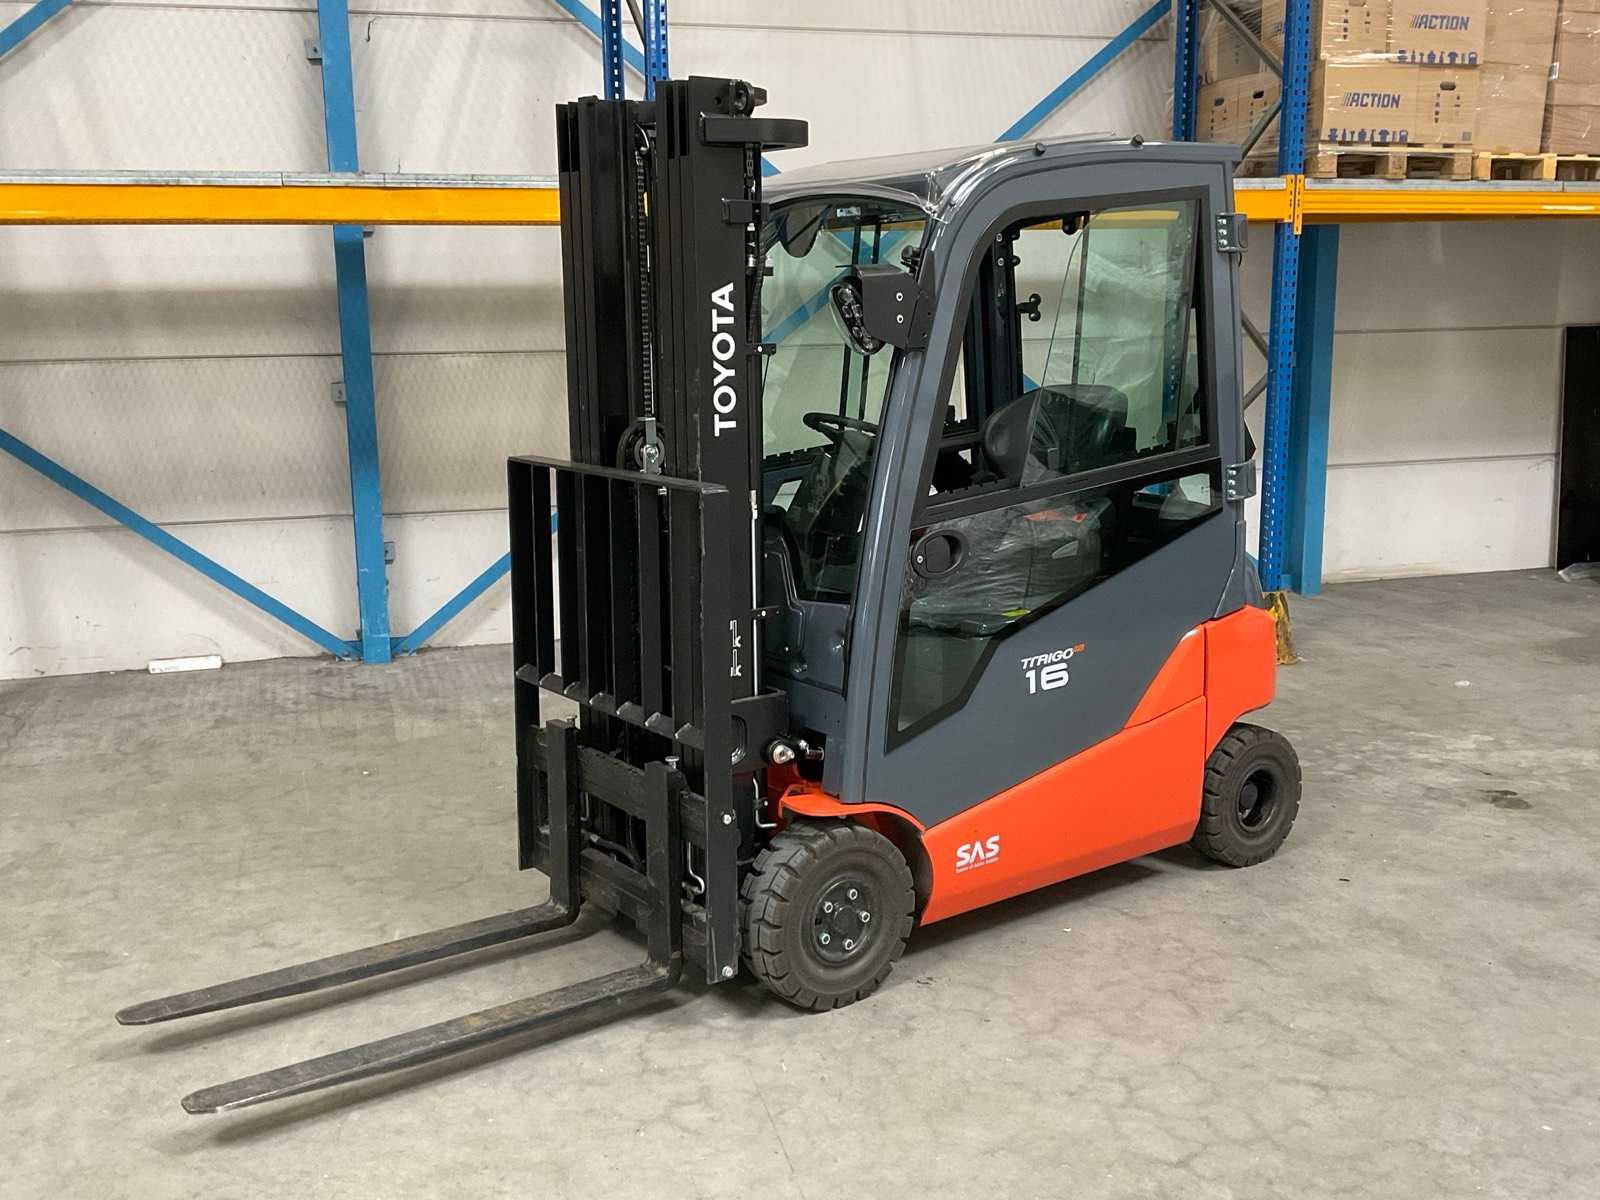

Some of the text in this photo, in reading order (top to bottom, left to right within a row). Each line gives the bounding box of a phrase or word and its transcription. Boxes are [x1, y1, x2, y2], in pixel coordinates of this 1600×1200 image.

[1416, 15, 1470, 31] ACTION
[1347, 92, 1401, 108] ACTION
[711, 282, 737, 437] TOYOTA
[1025, 663, 1069, 694] 16
[956, 834, 1000, 868] SAS
